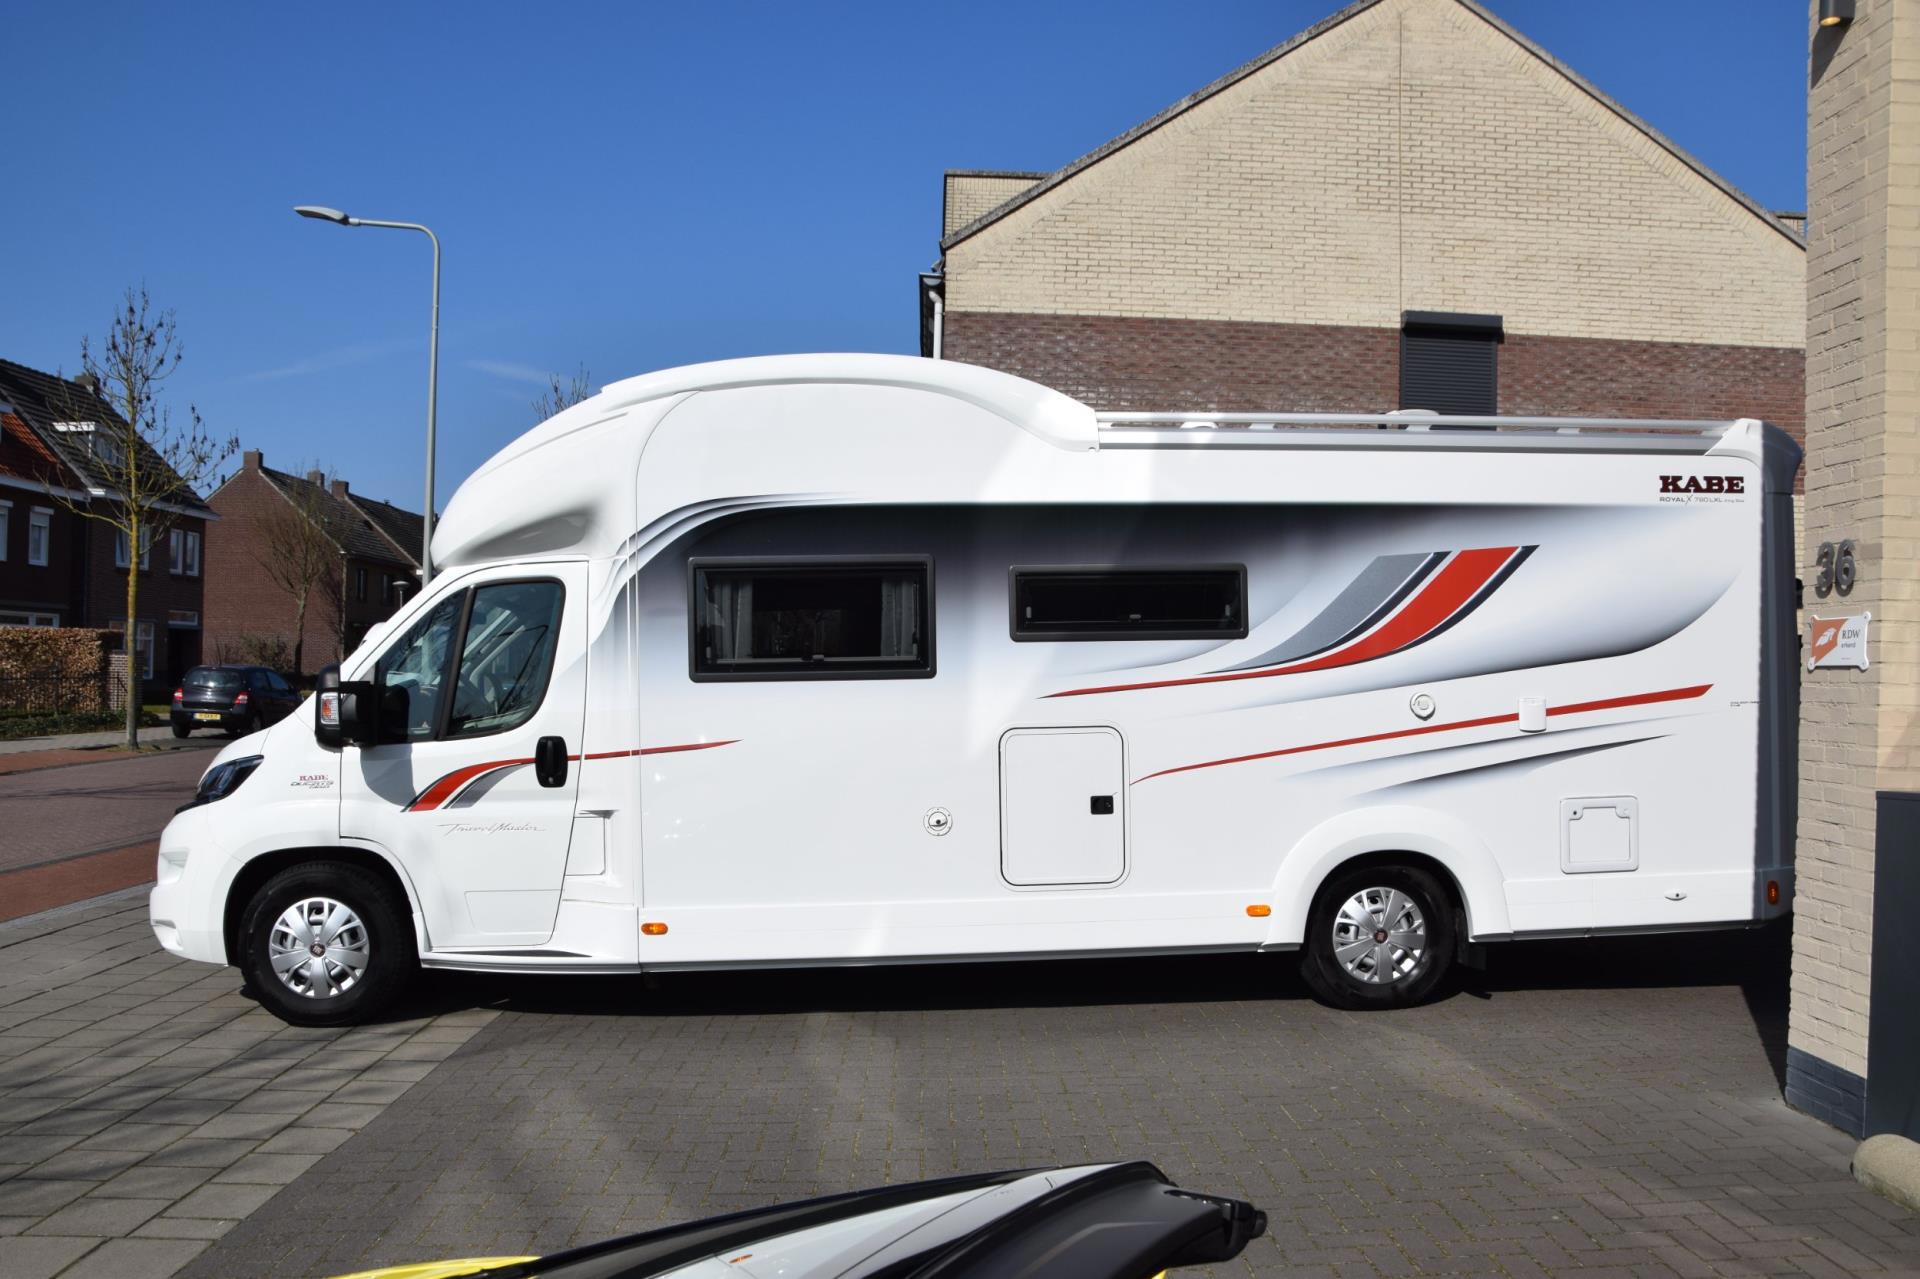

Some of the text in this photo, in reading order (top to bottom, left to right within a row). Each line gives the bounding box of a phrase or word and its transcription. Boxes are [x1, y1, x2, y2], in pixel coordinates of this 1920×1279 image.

[1659, 475, 1745, 494] KABE
[1815, 539, 1856, 599] 36
[1842, 629, 1861, 640] RDW
